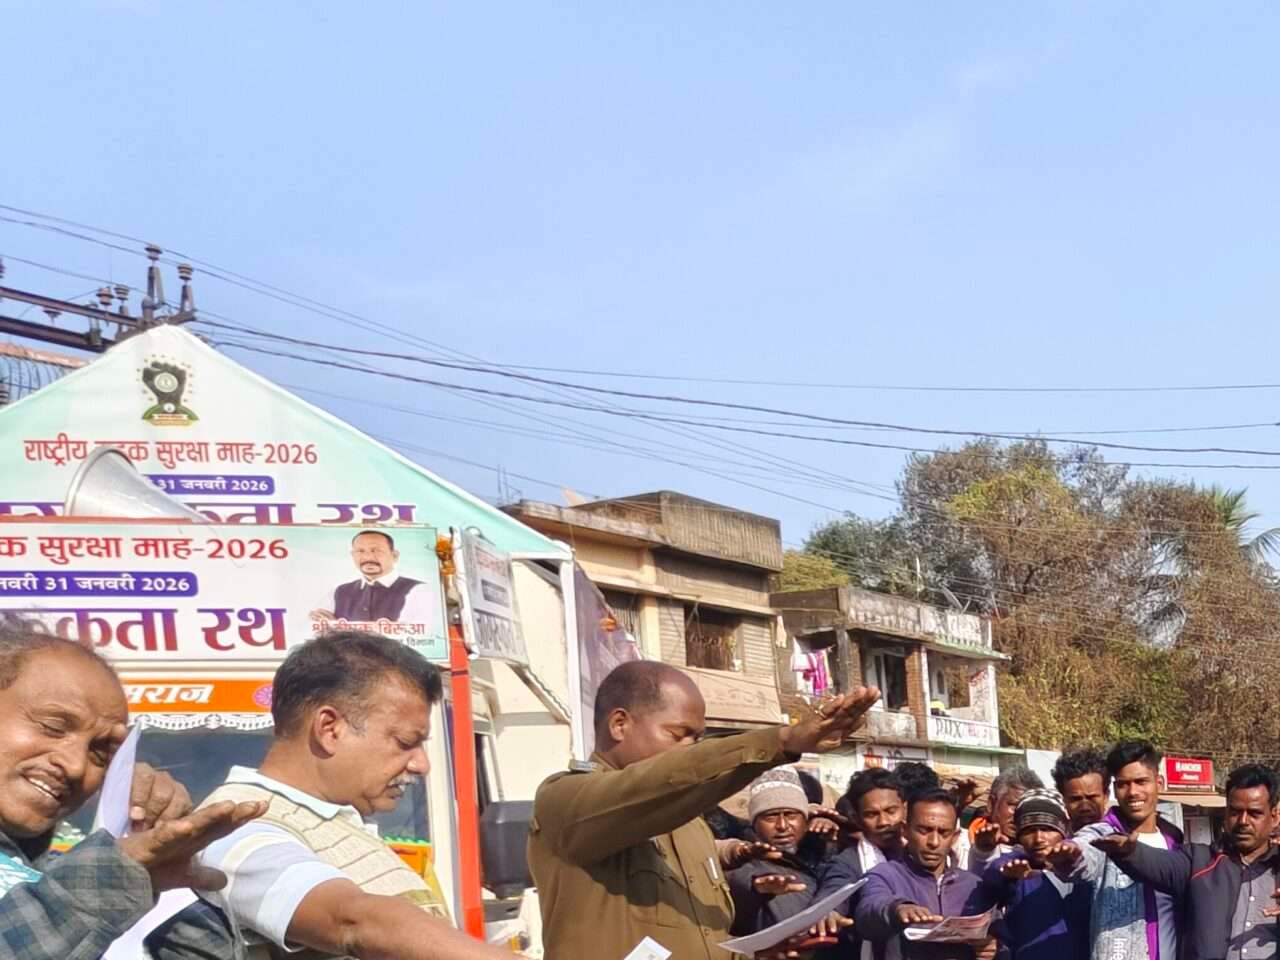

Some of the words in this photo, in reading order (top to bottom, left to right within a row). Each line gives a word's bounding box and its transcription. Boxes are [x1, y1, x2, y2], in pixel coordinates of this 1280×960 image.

[24, 432, 88, 466] राष्ट्रीय
[155, 441, 209, 469] सुरक्षा
[216, 441, 319, 465] माह-2026
[180, 475, 227, 491] जनवरी
[231, 479, 269, 492] 2026
[37, 536, 123, 566] सुरक्षा
[131, 537, 289, 560] माह-2026
[0, 573, 39, 591] नवरी
[45, 577, 68, 591] 31
[74, 573, 136, 592] जनवरी
[142, 577, 190, 591] 2026
[197, 607, 287, 652] रथ
